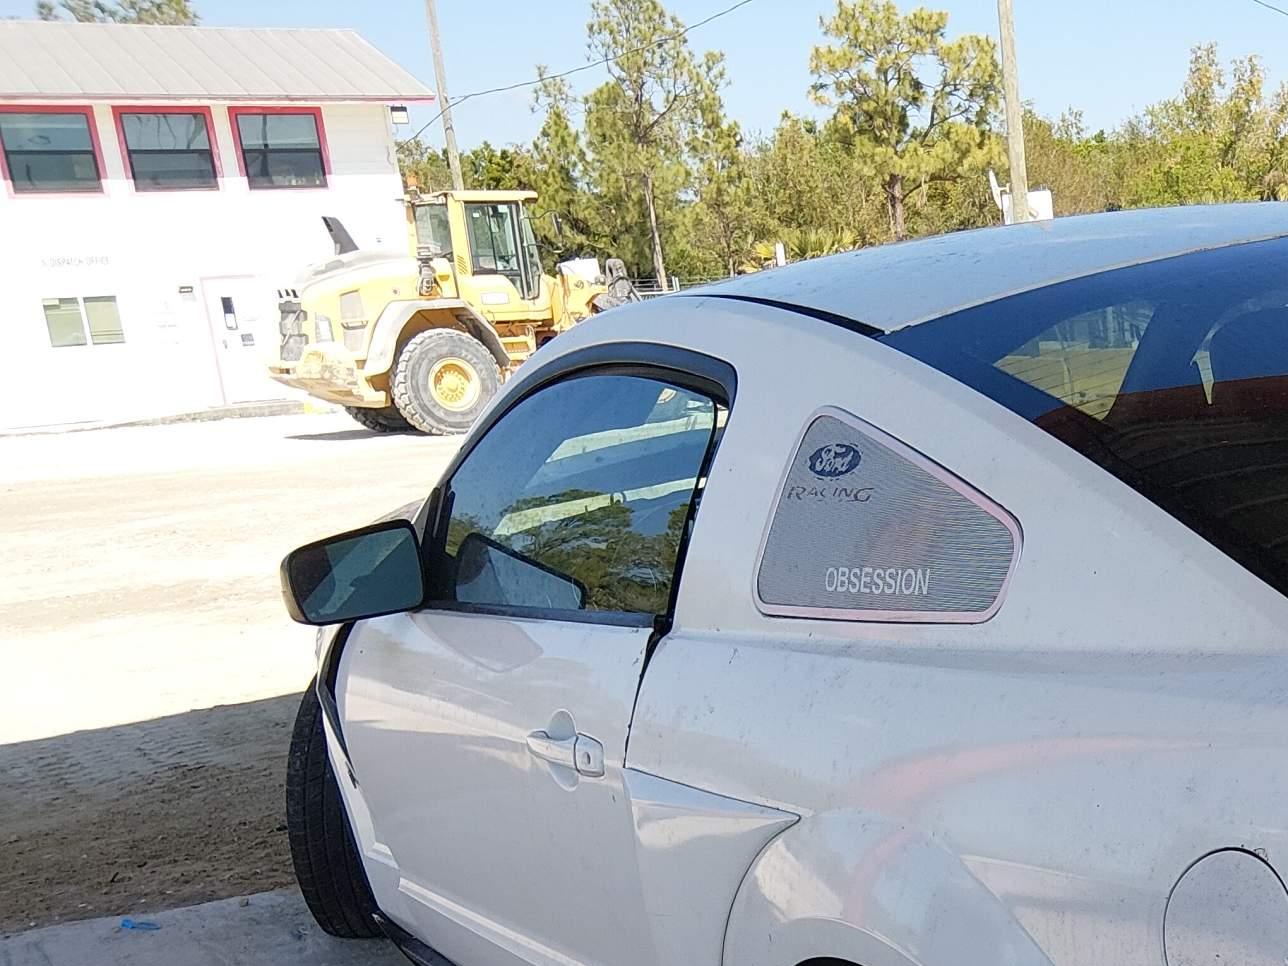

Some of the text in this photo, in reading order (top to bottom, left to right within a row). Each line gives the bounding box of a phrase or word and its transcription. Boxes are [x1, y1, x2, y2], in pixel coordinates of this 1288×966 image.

[814, 446, 855, 474] Ford
[787, 486, 875, 502] RACING
[825, 566, 931, 596] OBSESSION
